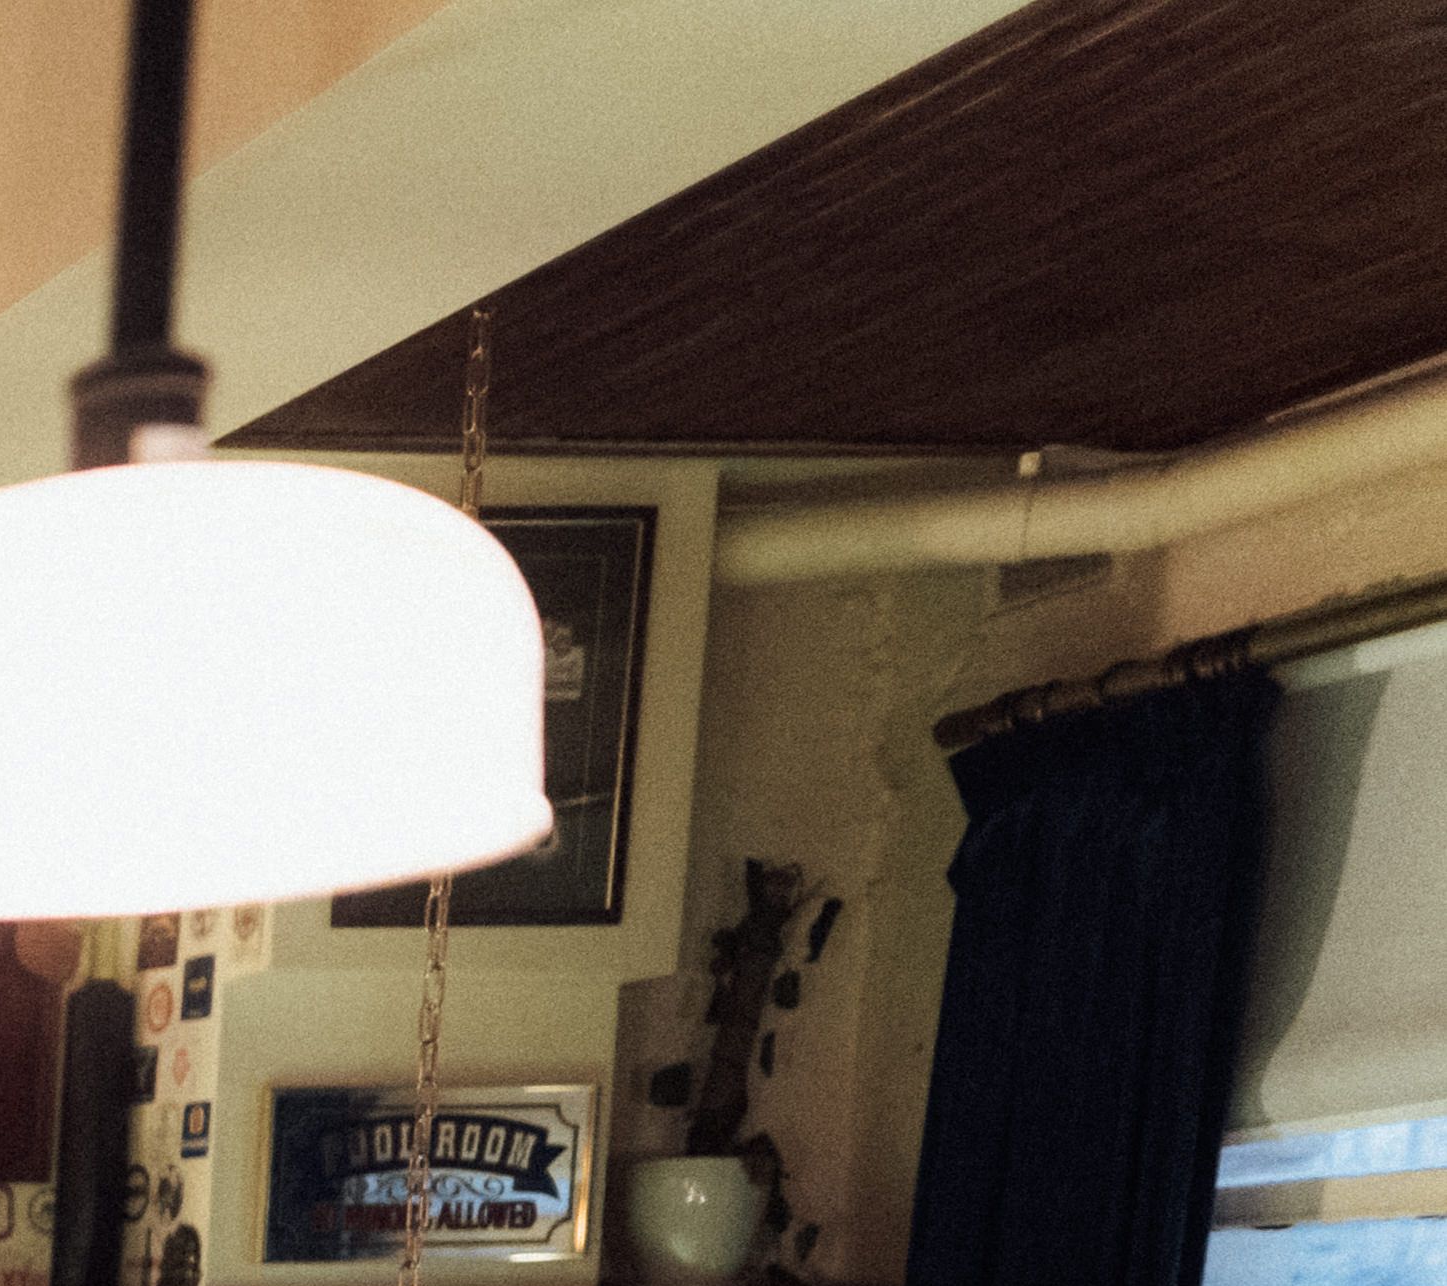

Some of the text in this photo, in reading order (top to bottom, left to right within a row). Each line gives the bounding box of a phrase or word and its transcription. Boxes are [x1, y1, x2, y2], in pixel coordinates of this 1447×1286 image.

[434, 1119, 538, 1171] ROOM
[344, 1202, 432, 1231] MINOR
[436, 1200, 539, 1231] ALLOWED
